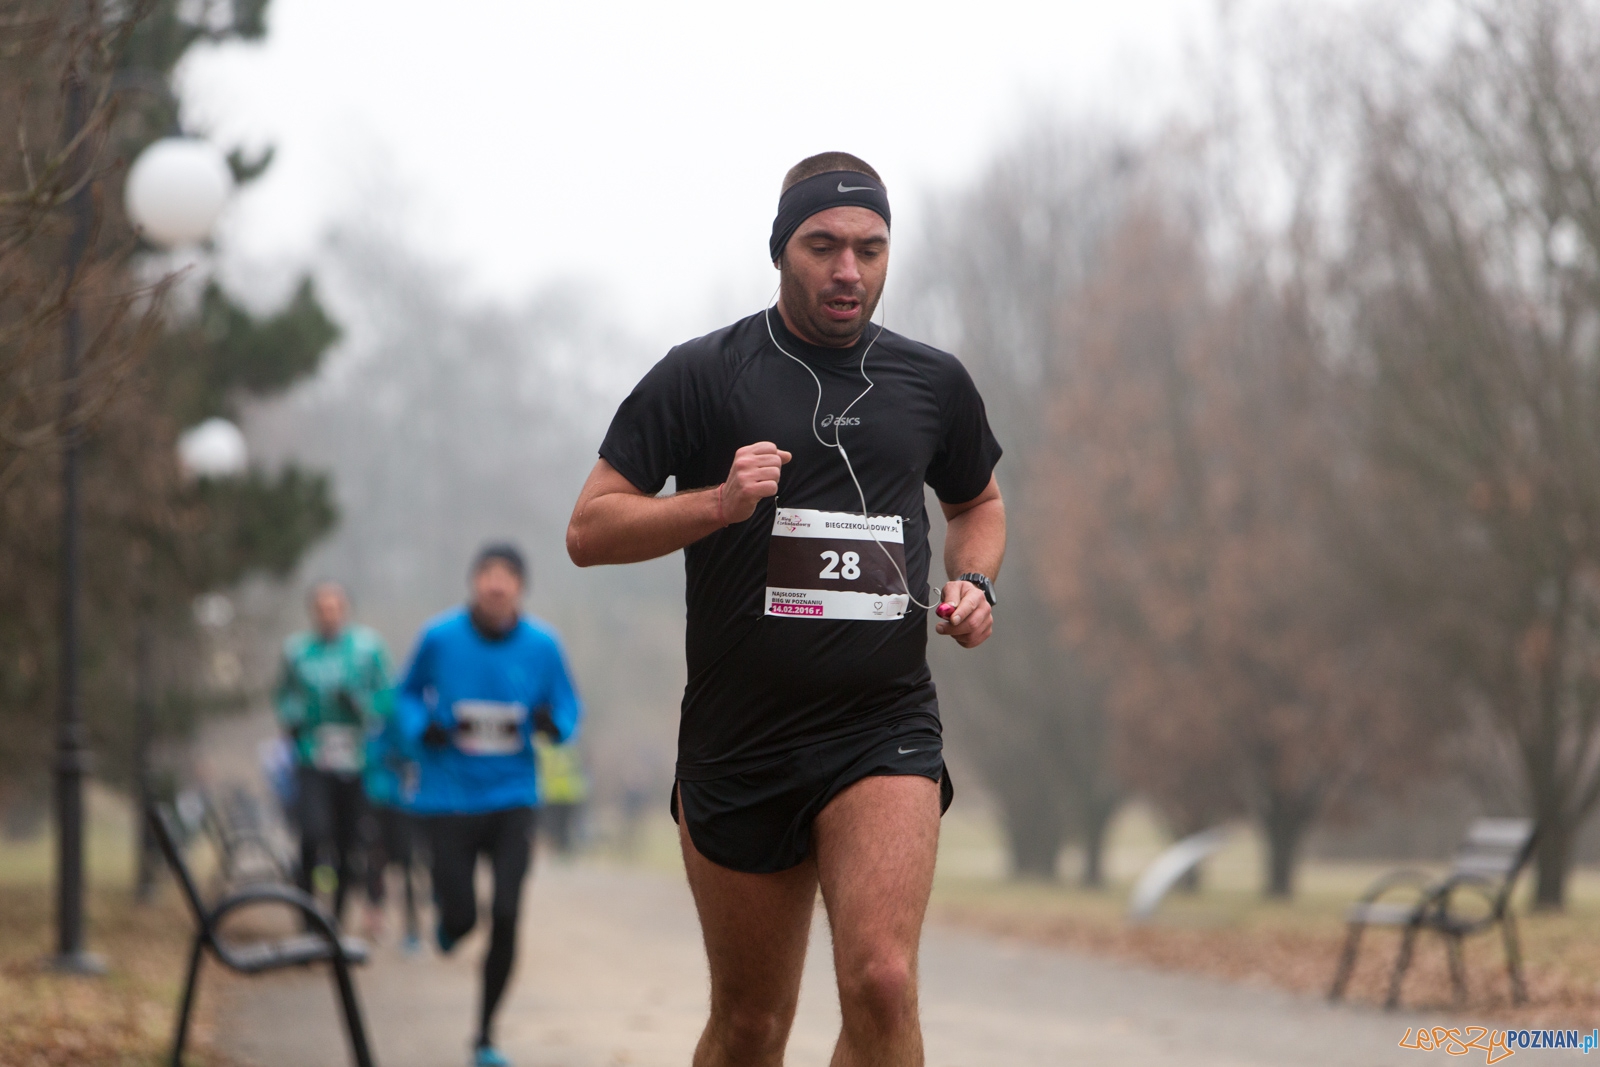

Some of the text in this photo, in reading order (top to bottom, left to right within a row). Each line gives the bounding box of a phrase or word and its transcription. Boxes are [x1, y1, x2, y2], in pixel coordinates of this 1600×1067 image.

[833, 417, 861, 426] asics
[819, 550, 861, 581] 28
[772, 605, 814, 614] 14.02.2016
